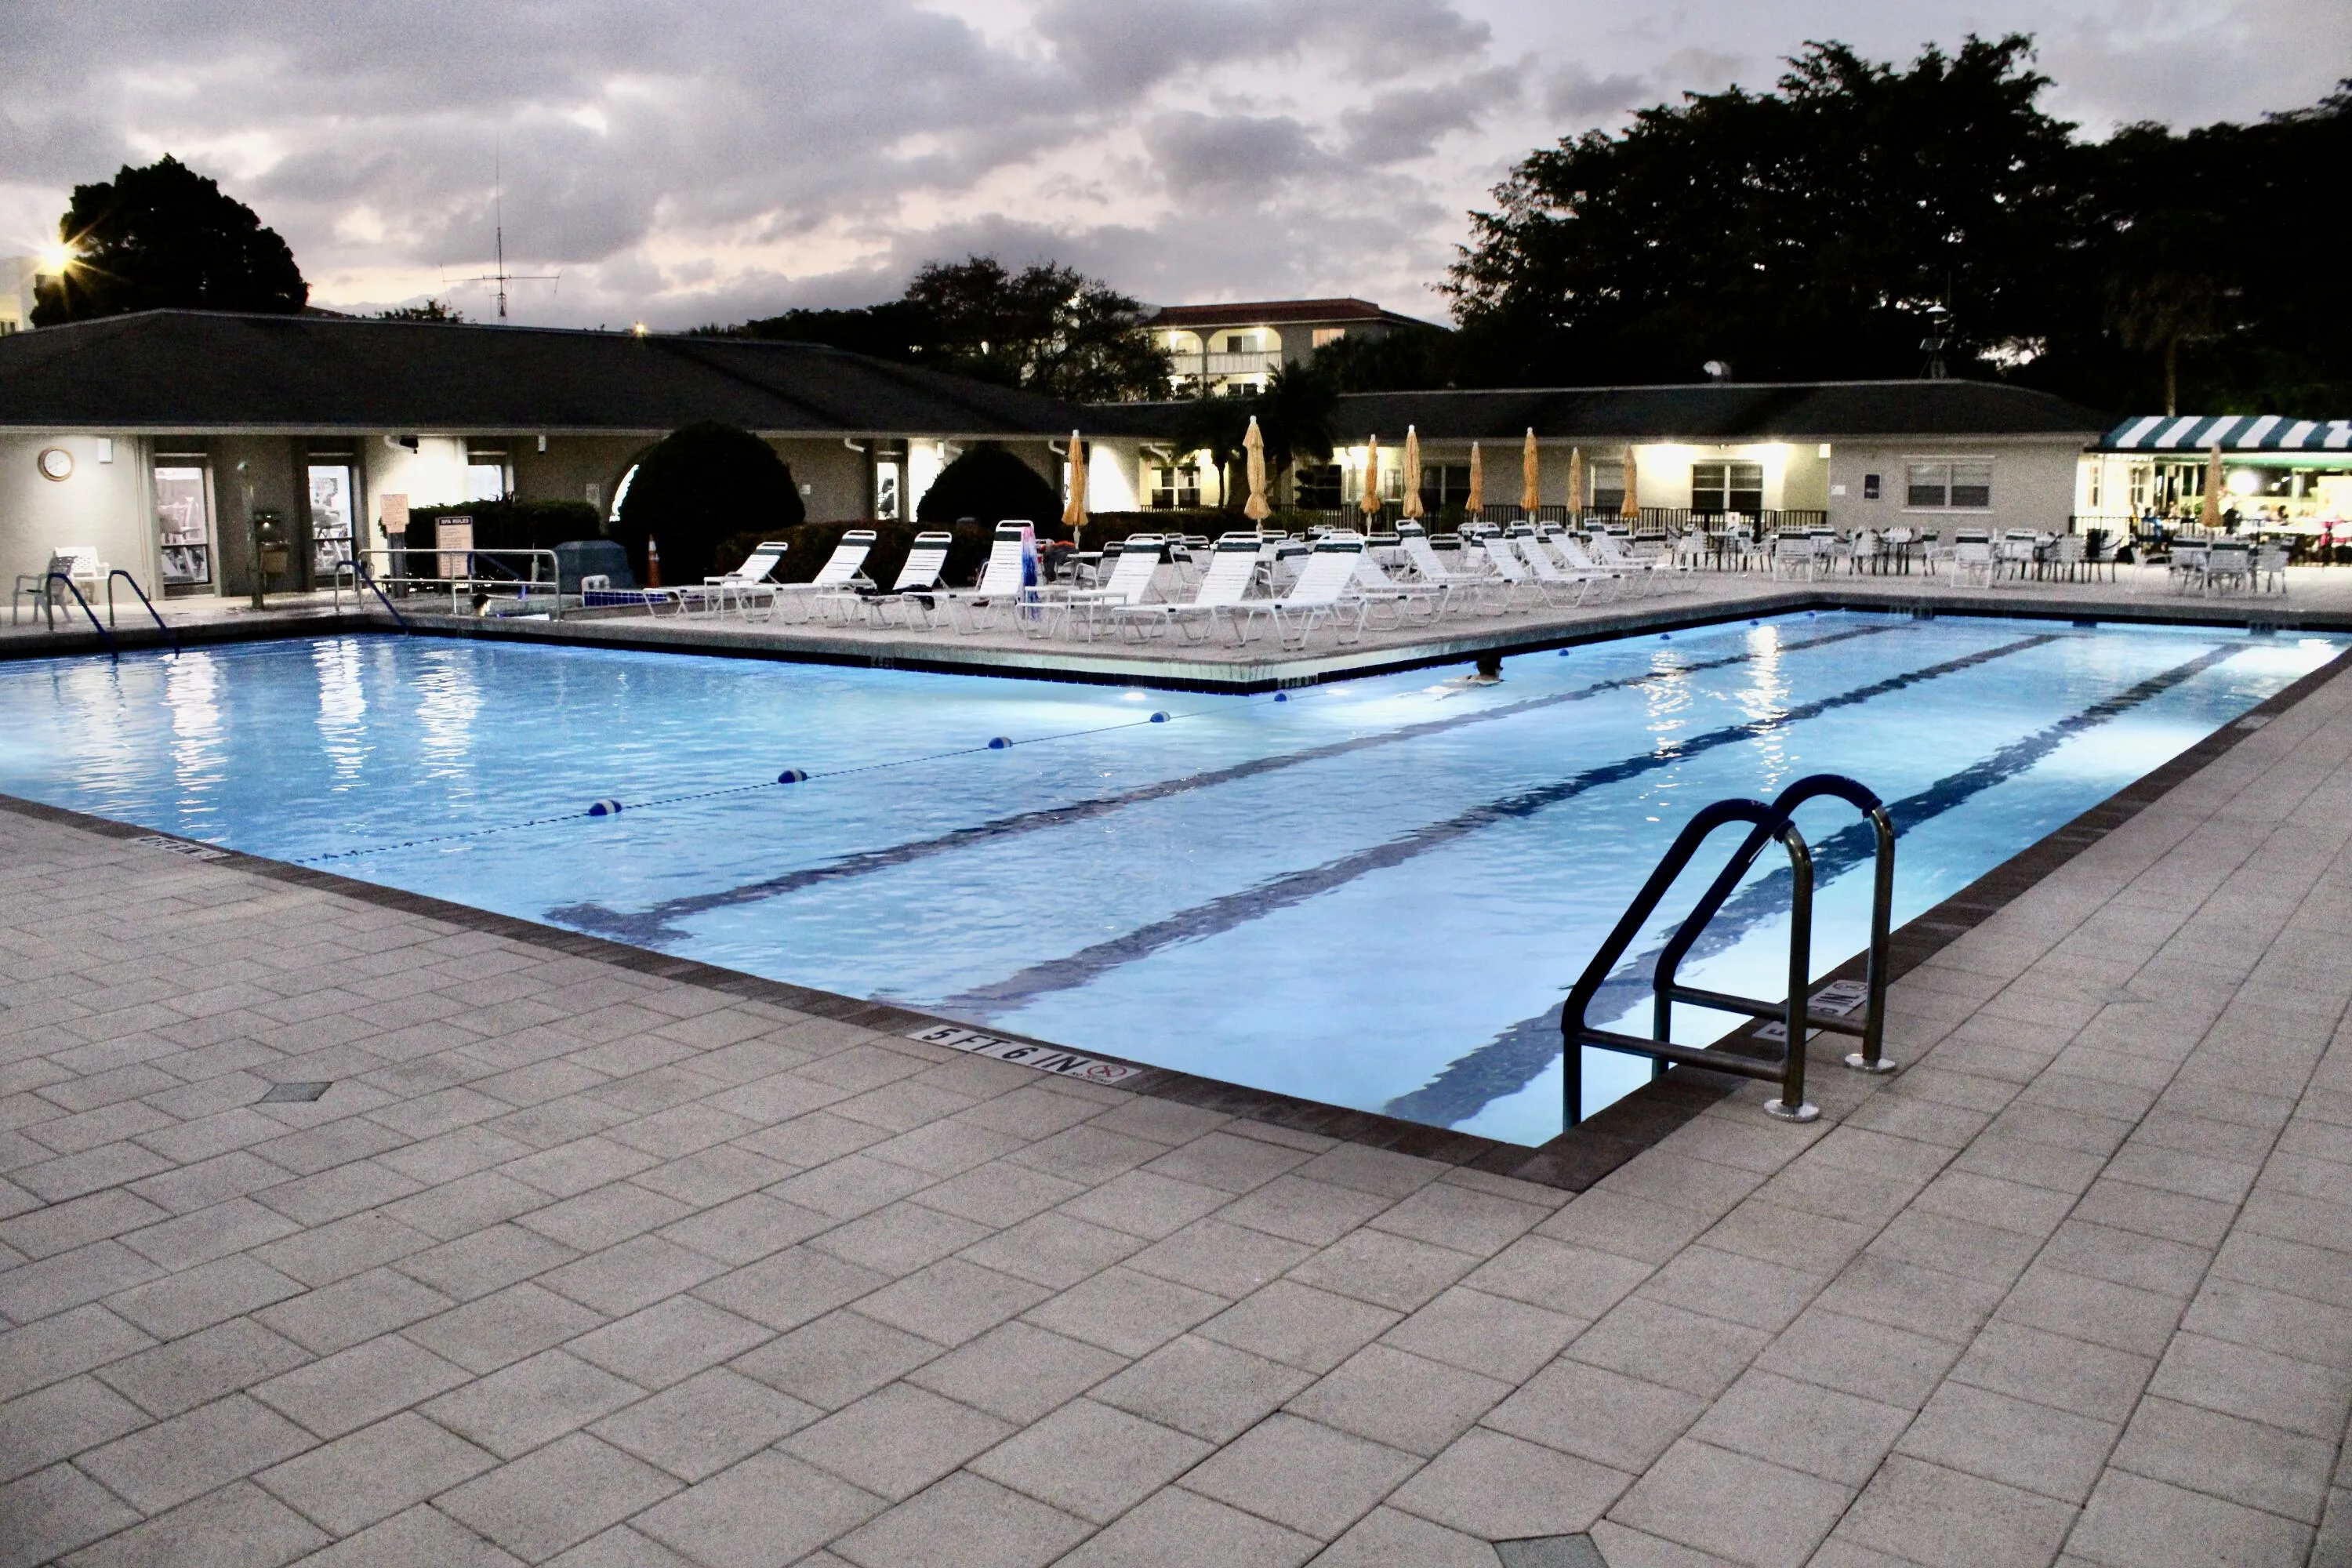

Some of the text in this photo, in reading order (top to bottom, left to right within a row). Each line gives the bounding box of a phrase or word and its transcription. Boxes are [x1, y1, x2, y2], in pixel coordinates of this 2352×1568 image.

[1815, 992, 1860, 1005] IN
[921, 1027, 1092, 1073] 5 FT 6 IN
